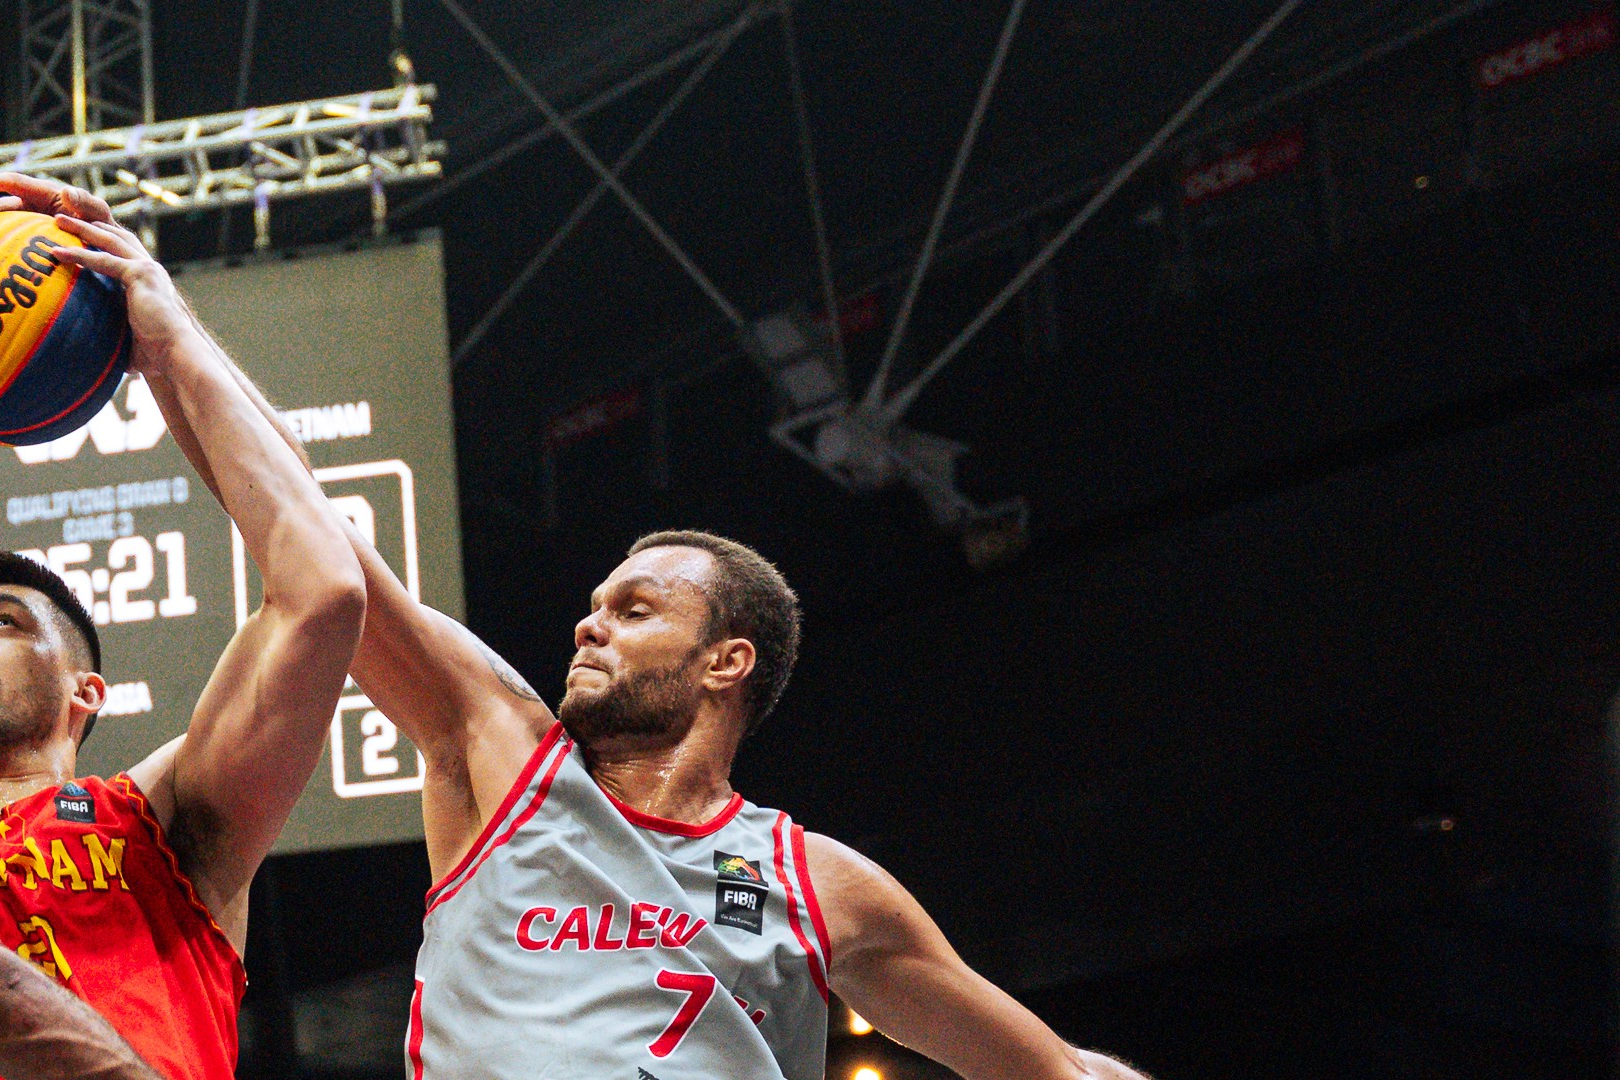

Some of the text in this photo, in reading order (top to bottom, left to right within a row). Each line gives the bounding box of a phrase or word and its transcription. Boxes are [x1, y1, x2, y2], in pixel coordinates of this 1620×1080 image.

[361, 710, 399, 776] 2
[60, 800, 88, 812] FIBA
[724, 890, 757, 910] FIBA
[647, 967, 716, 1058] 7
